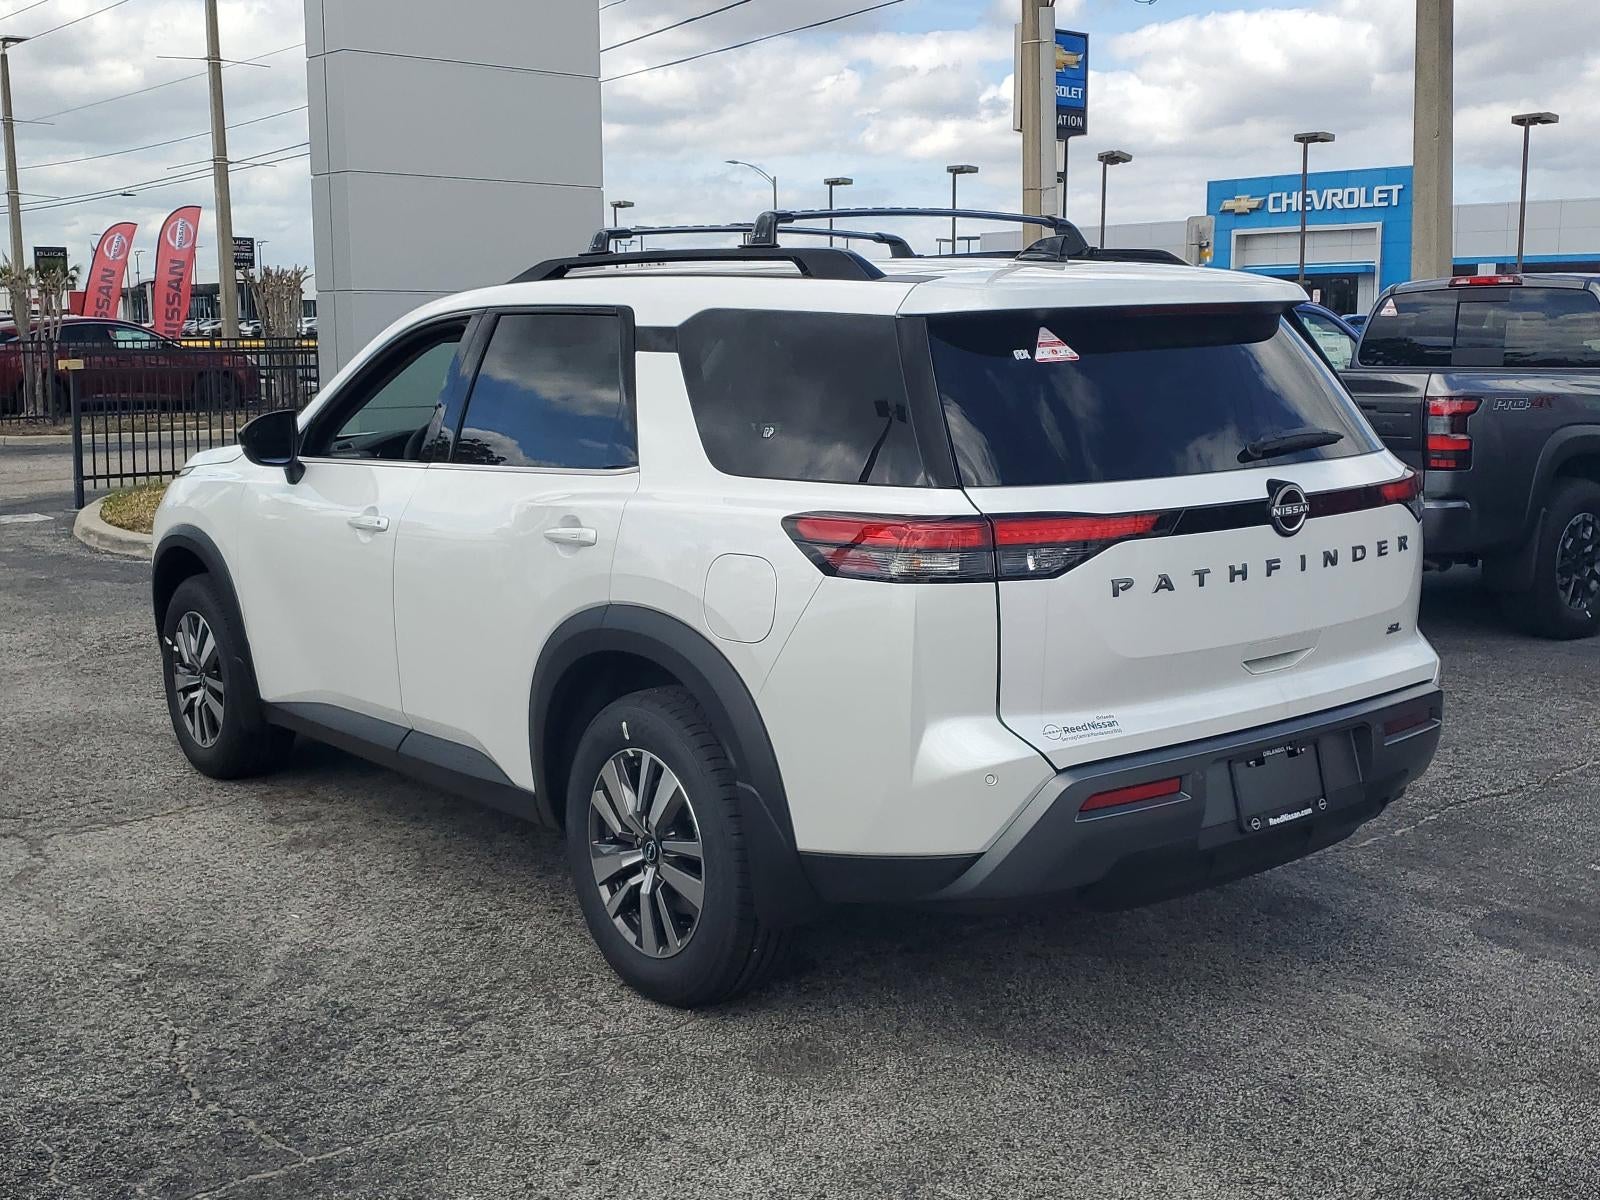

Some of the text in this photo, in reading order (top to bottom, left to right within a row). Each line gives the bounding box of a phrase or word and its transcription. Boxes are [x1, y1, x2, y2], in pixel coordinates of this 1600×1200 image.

[1057, 114, 1083, 127] ATION
[1267, 184, 1404, 213] CHEVROLET
[1273, 503, 1310, 517] NISSAN
[1110, 535, 1409, 598] PATHFINDER
